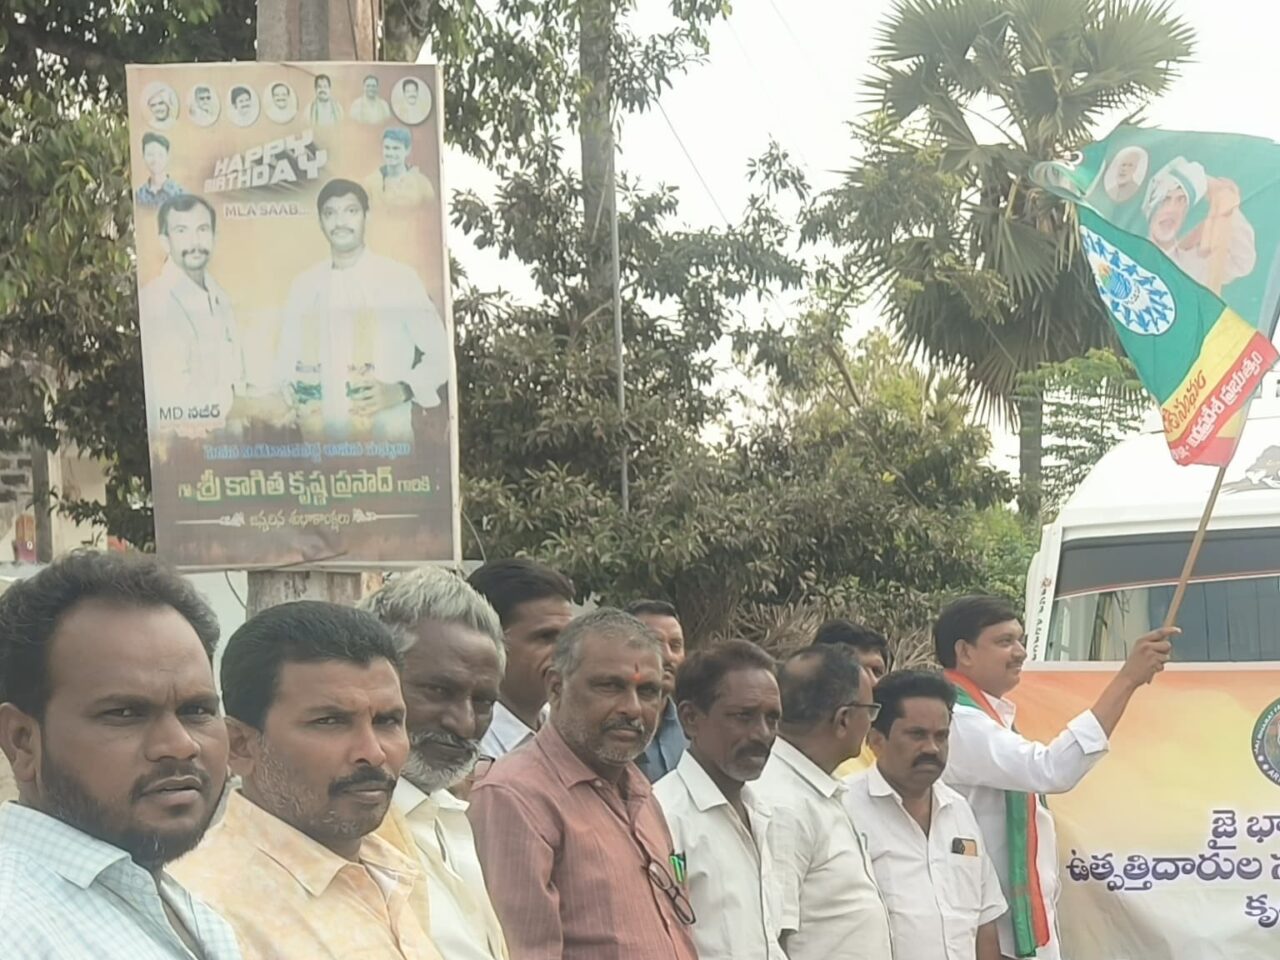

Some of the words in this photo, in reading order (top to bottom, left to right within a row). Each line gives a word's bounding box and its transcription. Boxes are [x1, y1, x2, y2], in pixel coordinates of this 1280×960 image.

[204, 149, 328, 193] BIRTHDAY
[213, 129, 313, 177] HAPPY
[225, 203, 256, 217] MLA
[159, 407, 184, 421] MD
[196, 469, 221, 501] శ్రీ
[225, 469, 286, 496] కాగిత
[289, 468, 328, 506] కృష్ణ
[330, 466, 393, 499] ప్రసాద్
[1208, 809, 1238, 850] జై
[1066, 849, 1263, 891] ఉత్పత్తిదారుల
